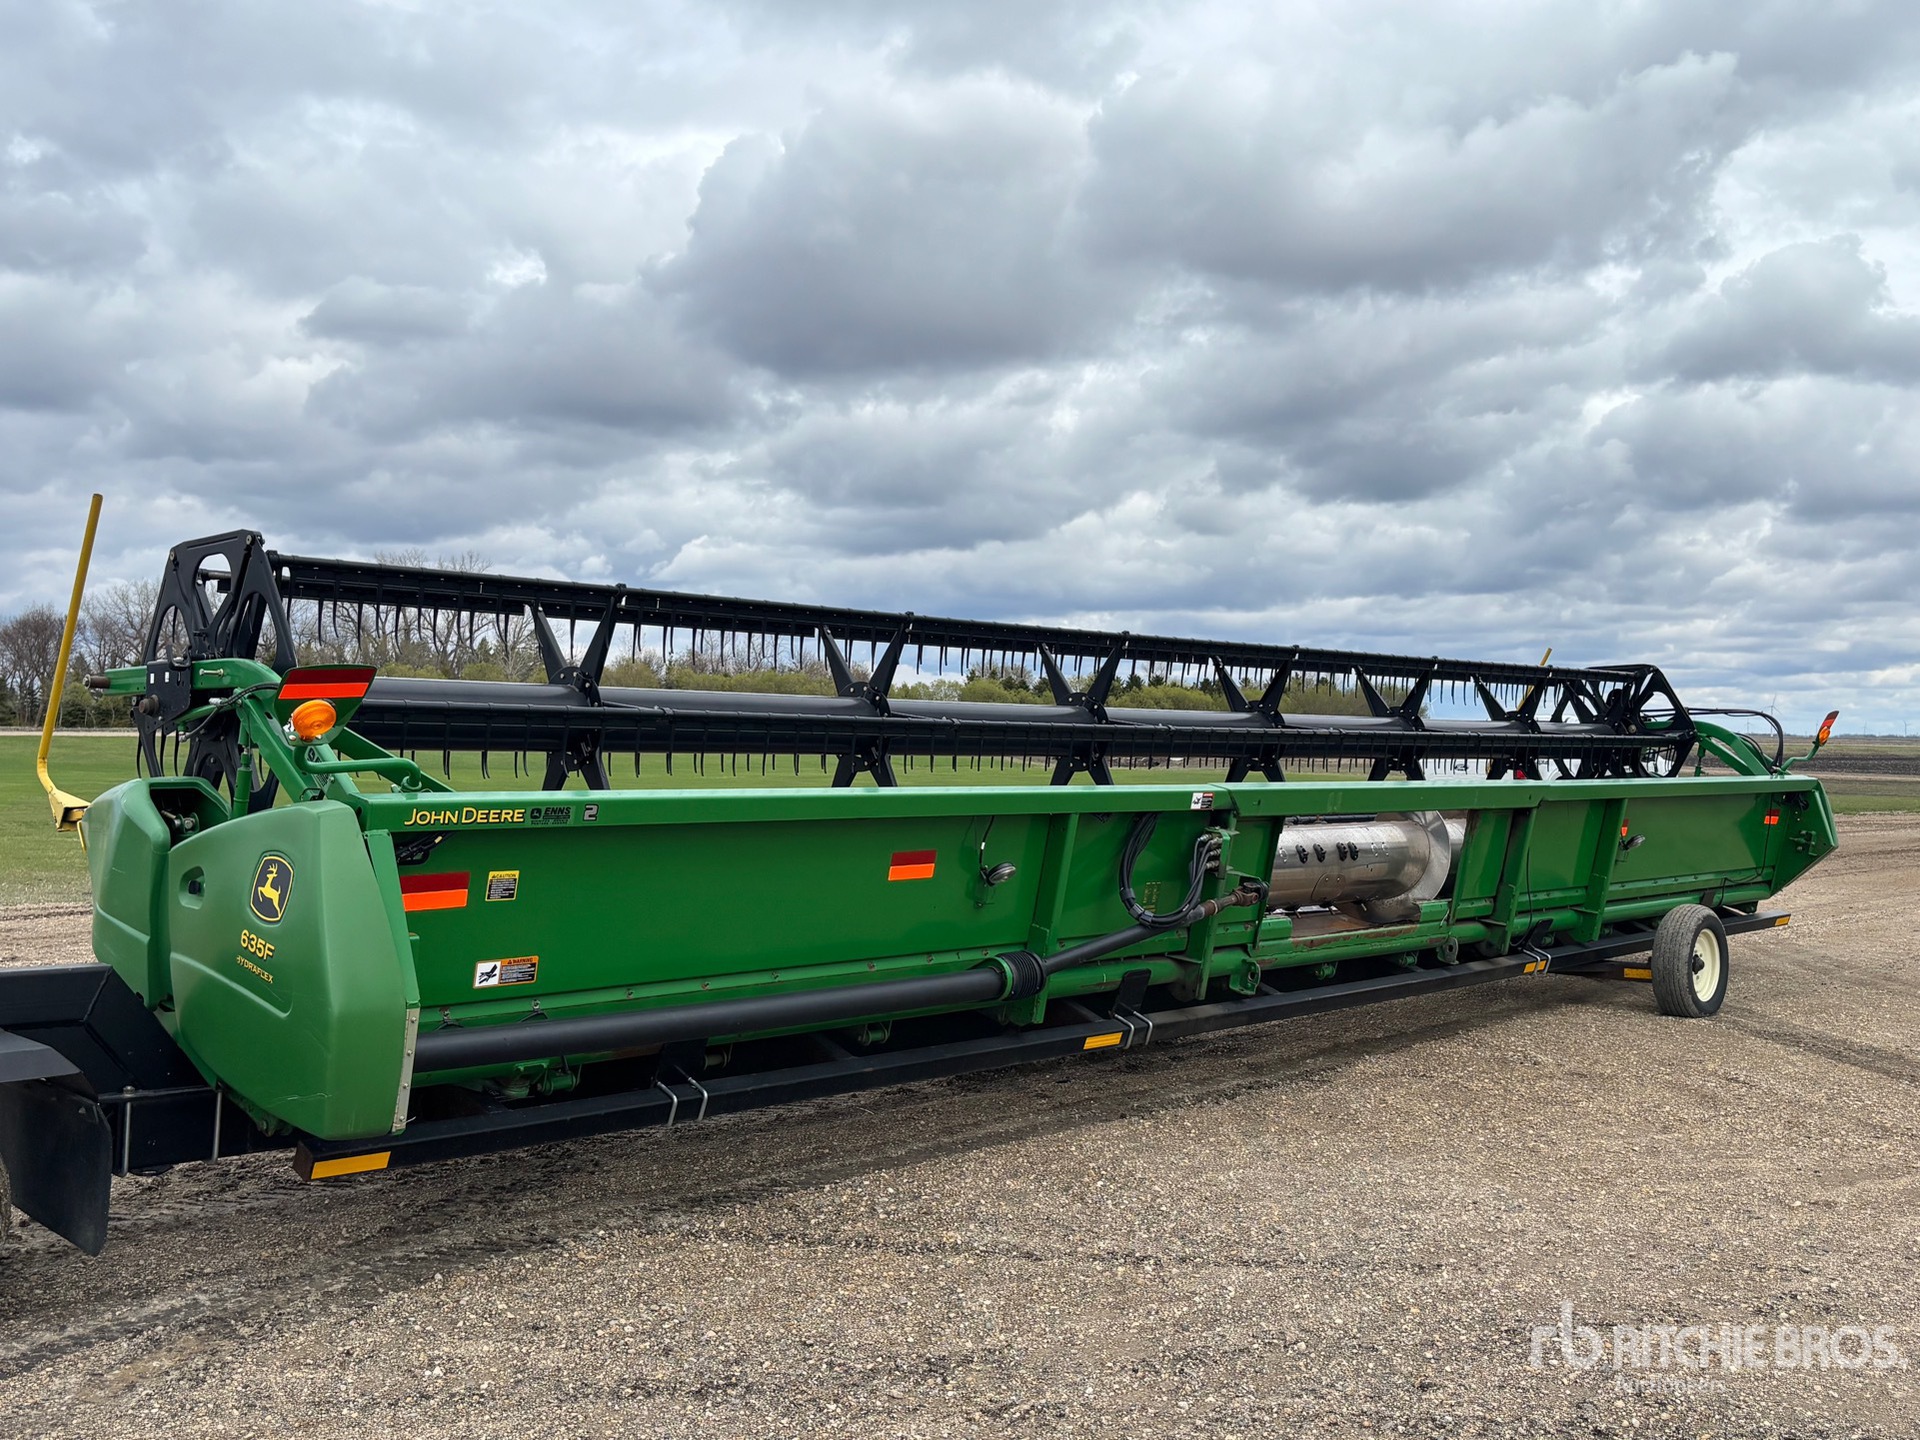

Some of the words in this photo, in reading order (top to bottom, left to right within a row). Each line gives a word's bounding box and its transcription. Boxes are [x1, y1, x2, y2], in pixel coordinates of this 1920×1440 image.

[404, 808, 459, 826] JOHN
[461, 807, 526, 824] DEERE
[544, 806, 571, 815] ENNS
[583, 804, 599, 821] 2
[240, 929, 275, 960] 635F
